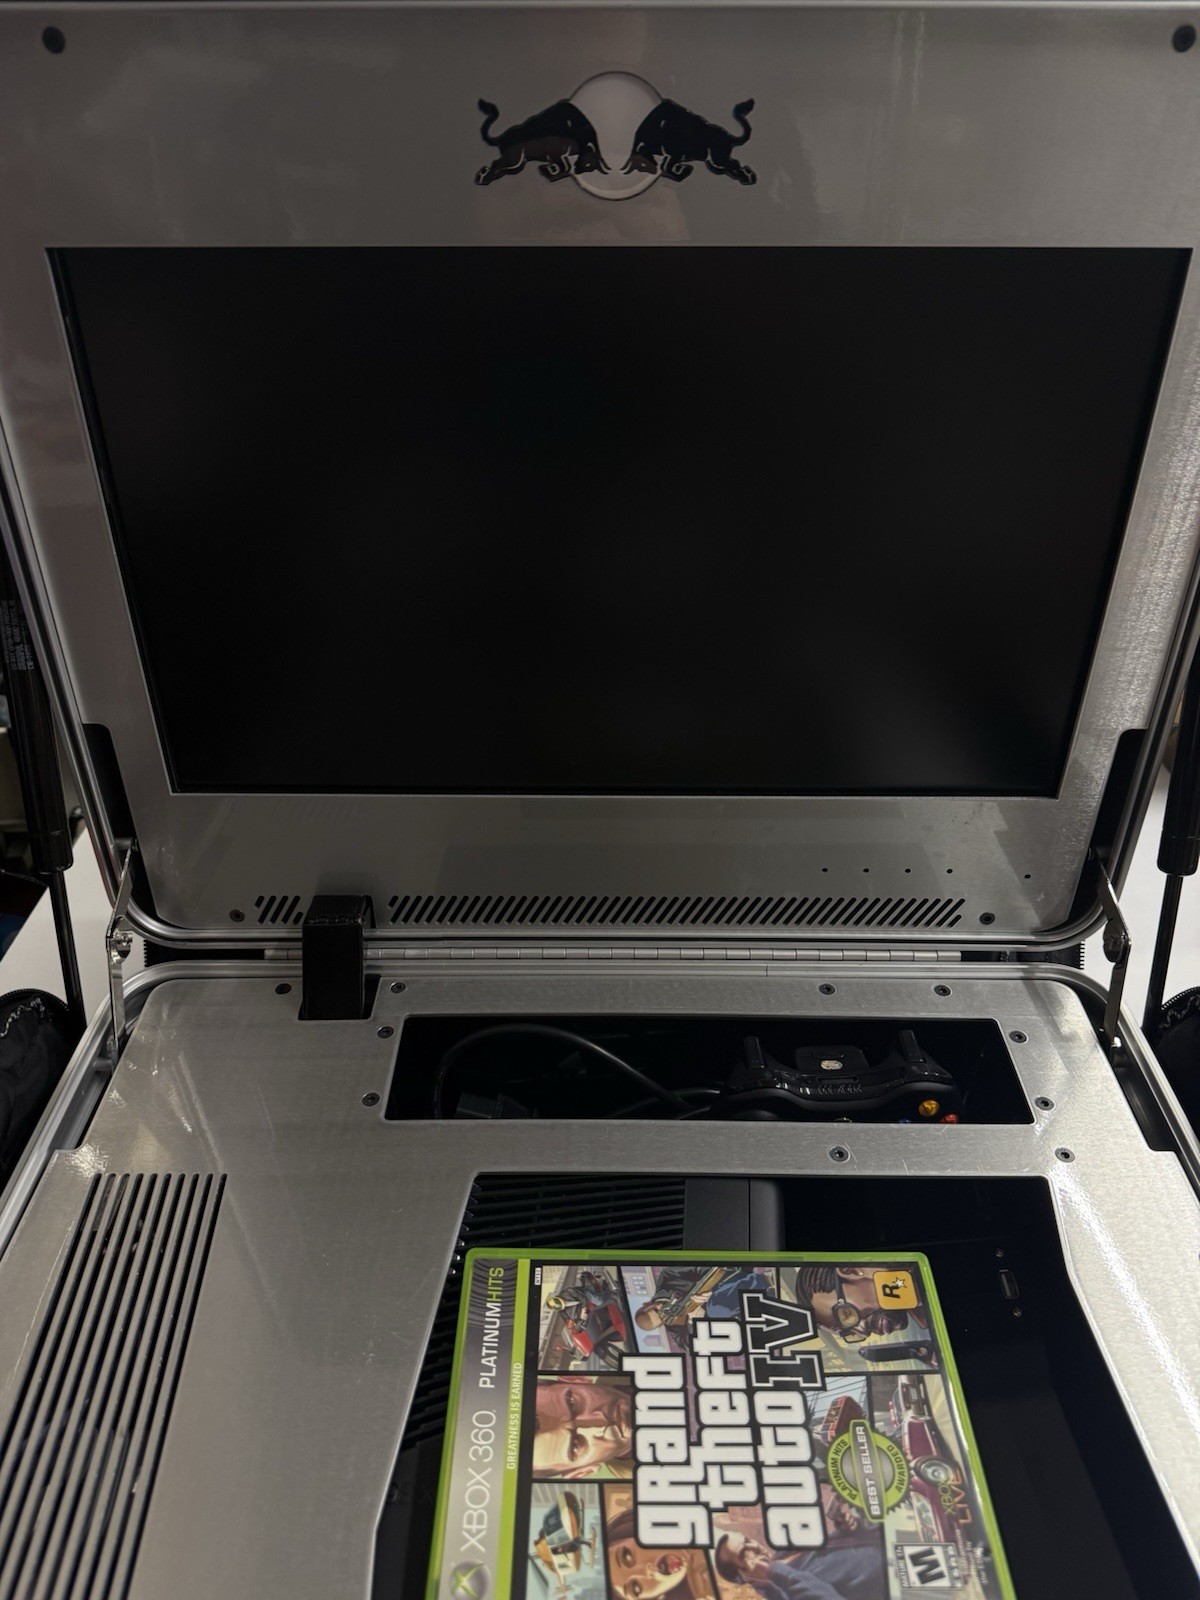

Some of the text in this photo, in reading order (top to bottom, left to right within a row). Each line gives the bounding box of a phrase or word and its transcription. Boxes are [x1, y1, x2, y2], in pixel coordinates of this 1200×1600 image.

[743, 1293, 823, 1387] IV
[507, 1363, 522, 1469] GREATNESS IS EARNED
[622, 1356, 710, 1547] grand
[690, 1321, 758, 1508] theft
[460, 1410, 496, 1552] XBOX 360
[754, 1391, 826, 1547] auto
[831, 1439, 857, 1500] PLATINUM HITS
[855, 1426, 881, 1515] BEST SELLER
[887, 1445, 906, 1493] AWARDED
[938, 1480, 956, 1514] XBOX
[951, 1468, 972, 1524] LIVE
[898, 1559, 909, 1587] MATURE
[908, 1547, 946, 1585] M
